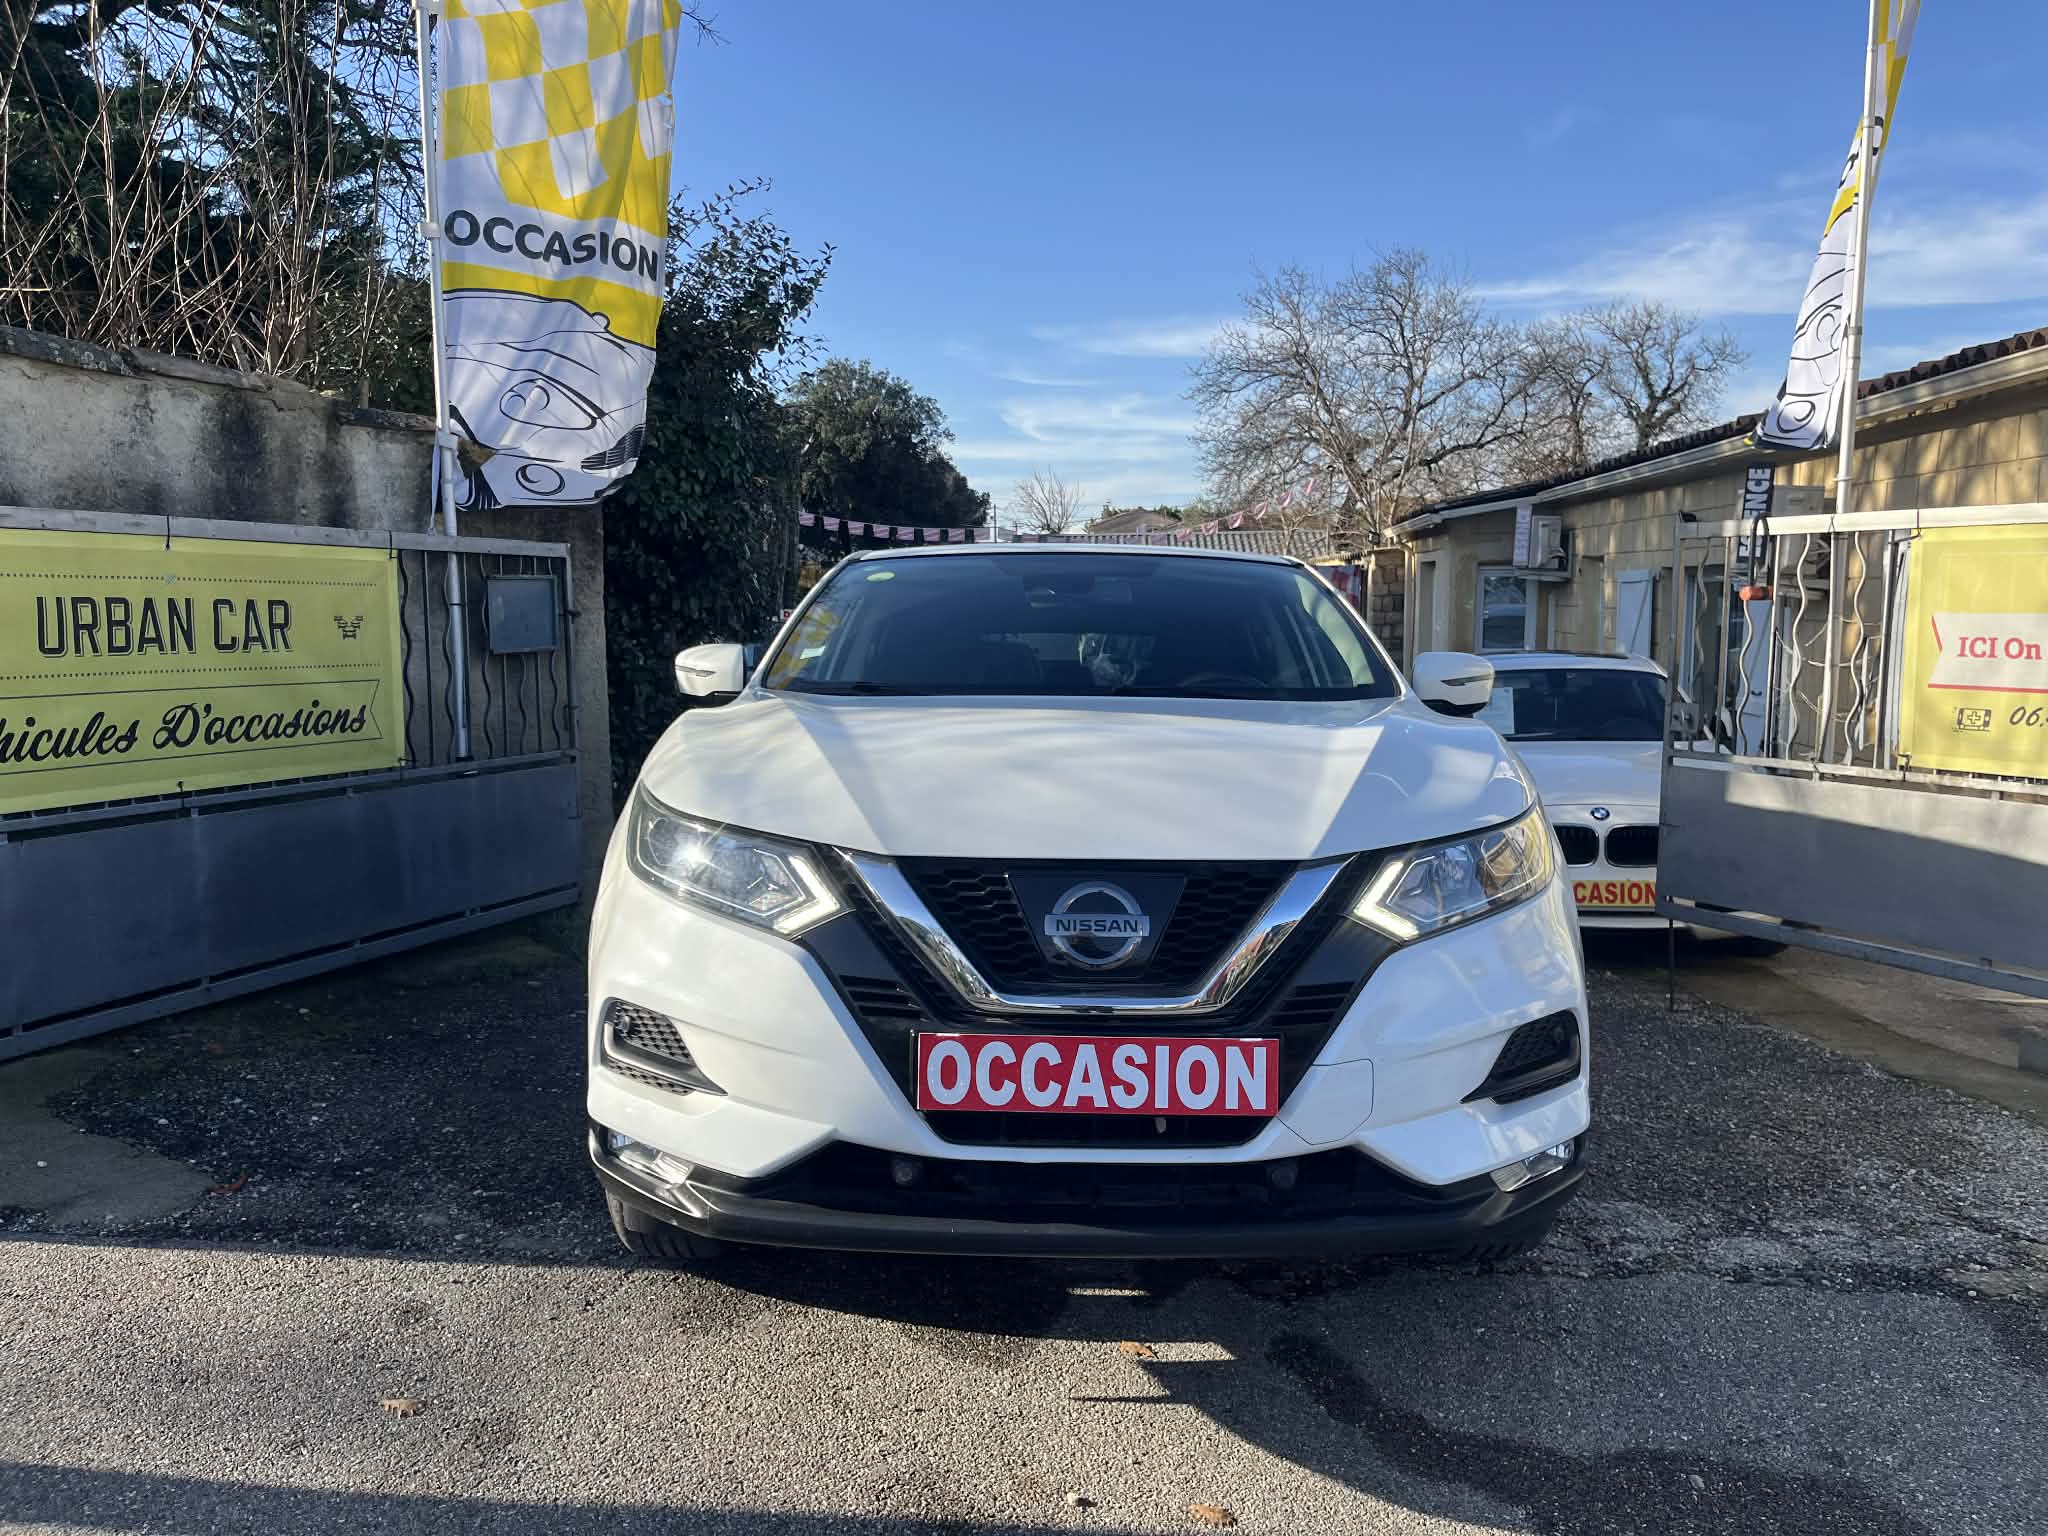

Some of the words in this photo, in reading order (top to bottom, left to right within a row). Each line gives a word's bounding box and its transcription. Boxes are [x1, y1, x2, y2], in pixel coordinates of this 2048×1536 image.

[443, 209, 659, 282] OCCASION
[36, 596, 197, 658] URBAN
[213, 598, 295, 655] CAR
[1957, 637, 1999, 659] ICI
[2003, 637, 2043, 660] On
[153, 698, 367, 749] D'occasions
[1055, 918, 1139, 933] NISSAN
[926, 1040, 1268, 1111] OCCASION
